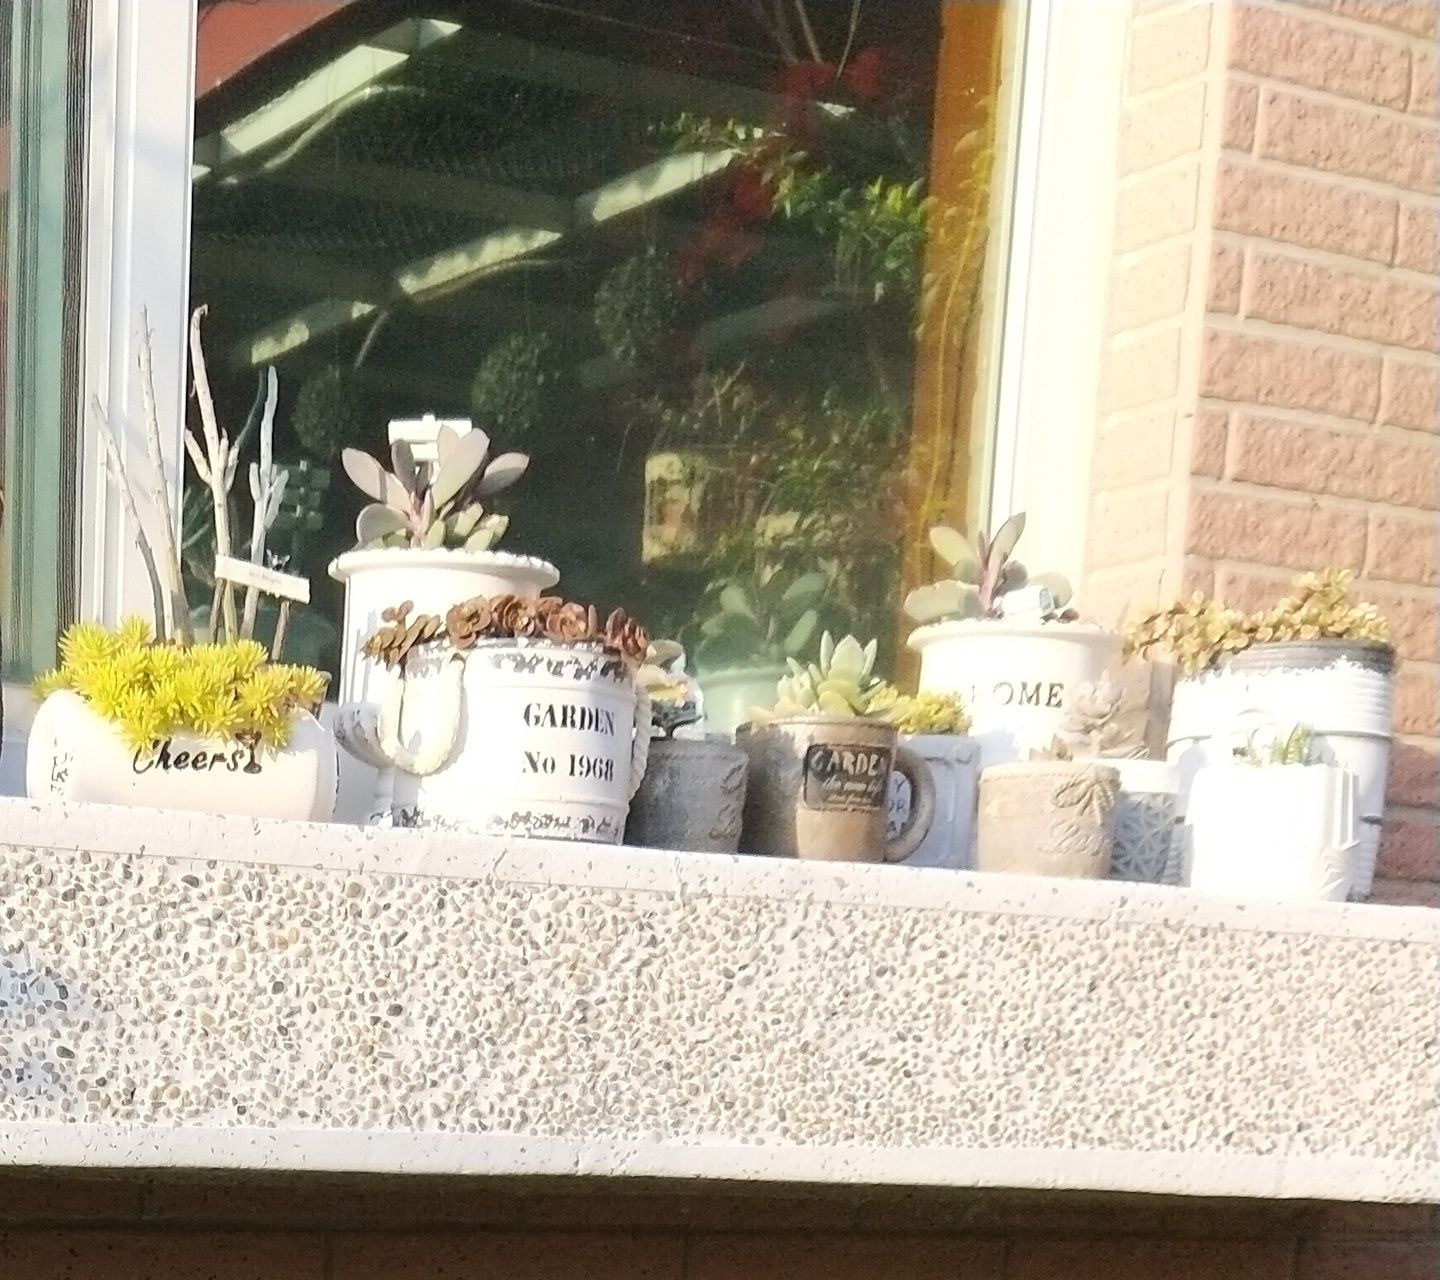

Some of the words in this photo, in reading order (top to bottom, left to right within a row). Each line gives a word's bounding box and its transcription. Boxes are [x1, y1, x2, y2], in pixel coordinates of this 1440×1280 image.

[523, 703, 614, 736] GARDEN
[523, 751, 556, 774] No
[569, 753, 614, 781] 1968
